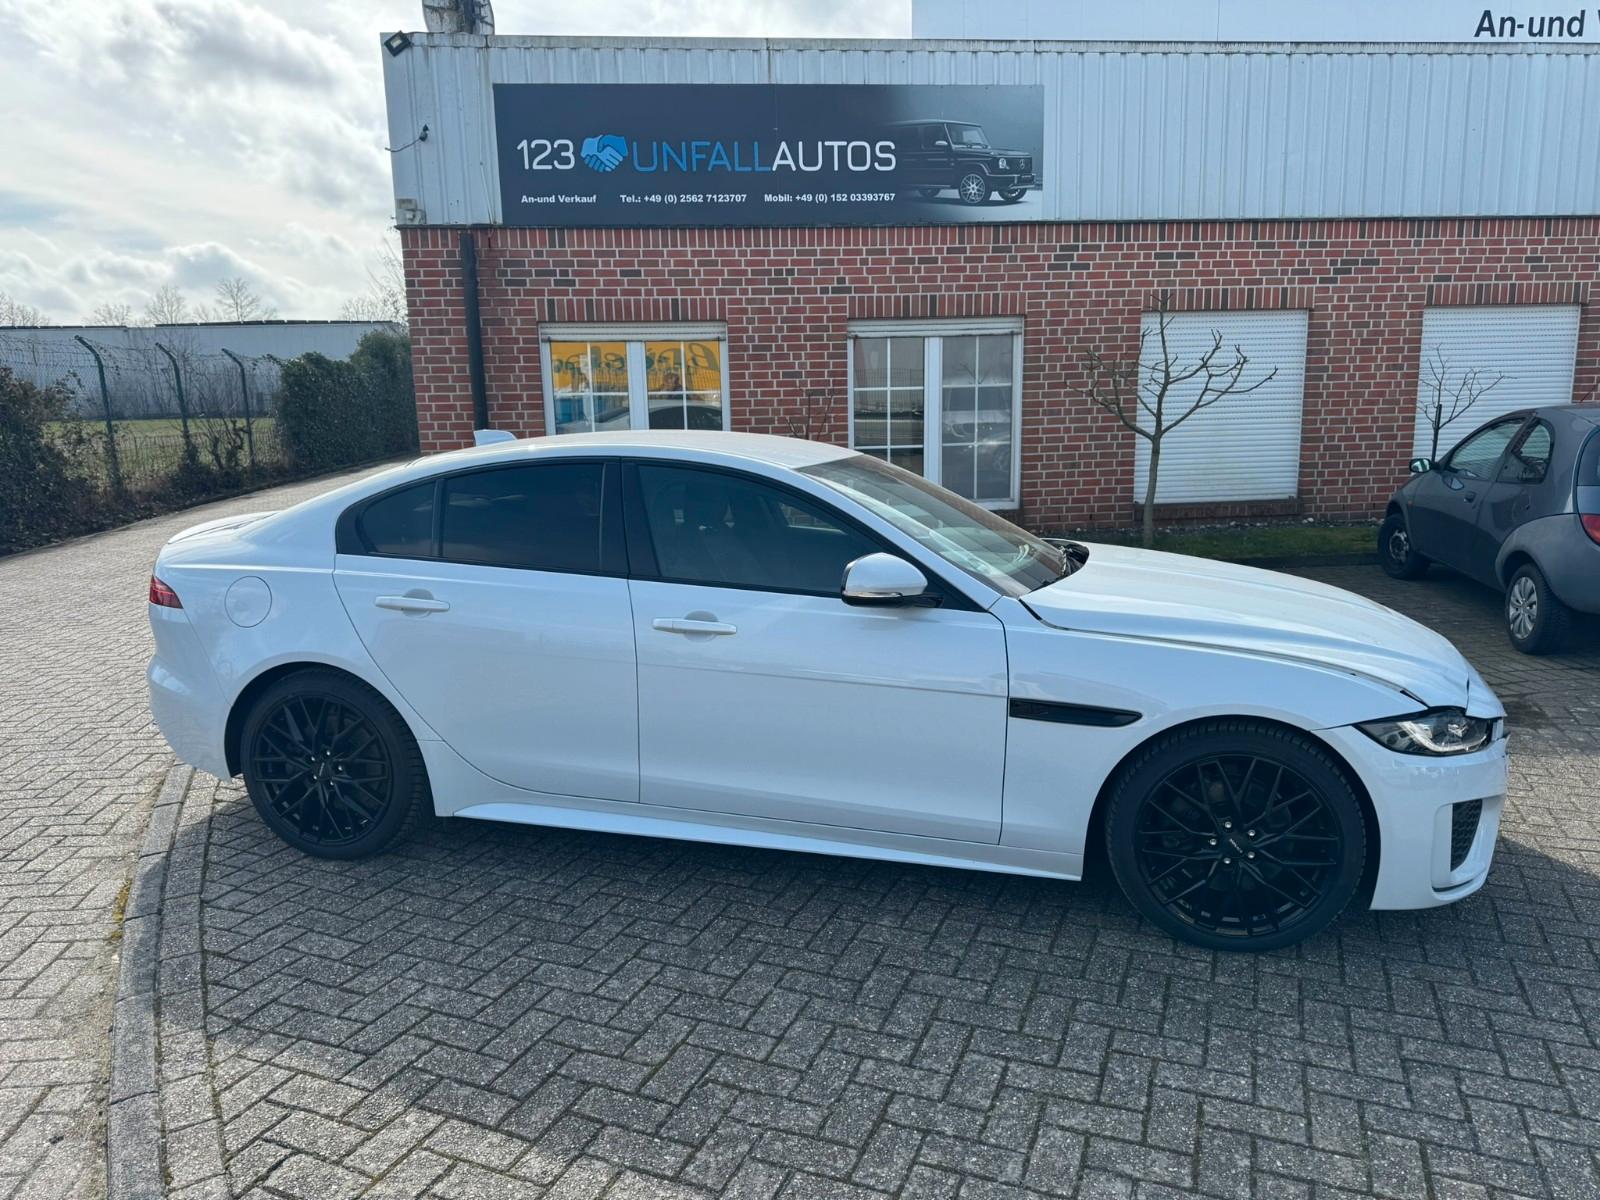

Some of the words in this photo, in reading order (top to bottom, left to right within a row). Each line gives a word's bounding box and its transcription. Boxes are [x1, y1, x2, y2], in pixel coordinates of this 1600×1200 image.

[1474, 9, 1586, 38] An-und
[516, 139, 576, 170] 123
[521, 194, 555, 203] An-und
[558, 194, 597, 203] Verkauf
[620, 194, 641, 203] Tel.:
[644, 194, 662, 203] +49
[664, 193, 678, 204] (0)
[680, 194, 704, 203] 2562
[706, 194, 747, 203] 7123707
[764, 193, 793, 203] Mobil:
[795, 194, 813, 202] +49
[815, 193, 828, 204] (0)
[830, 193, 848, 202] 152
[850, 193, 896, 202] 03393767
